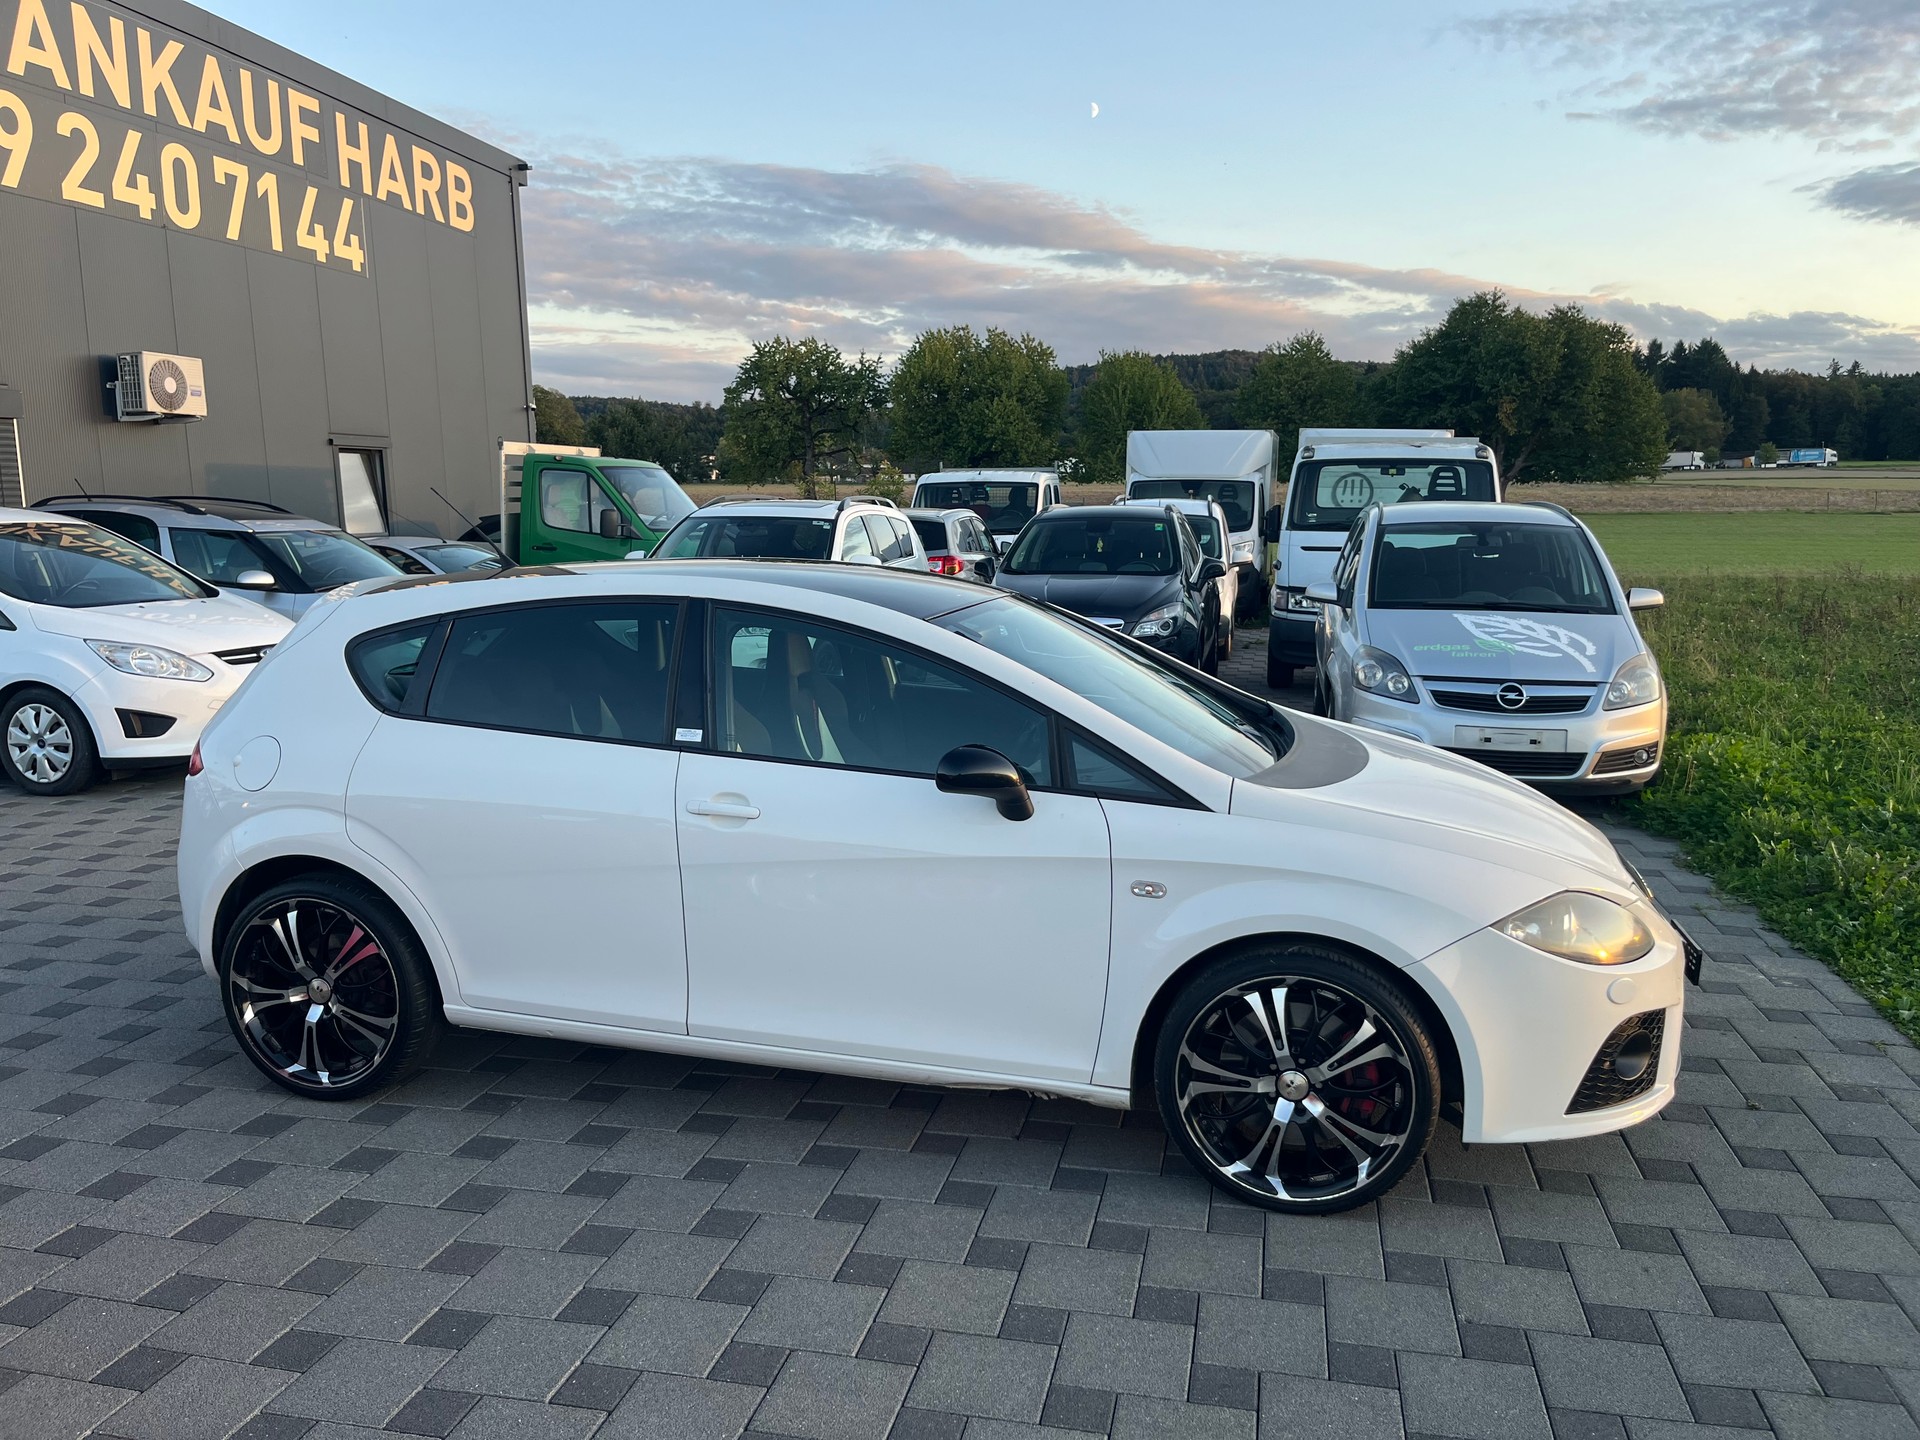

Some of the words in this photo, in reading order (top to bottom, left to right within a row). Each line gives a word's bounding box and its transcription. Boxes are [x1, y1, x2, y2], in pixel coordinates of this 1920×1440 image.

[7, 0, 320, 166] ANKAUF
[335, 112, 475, 232] HARB
[1413, 643, 1471, 652] erdgas
[1451, 650, 1497, 658] fahren
